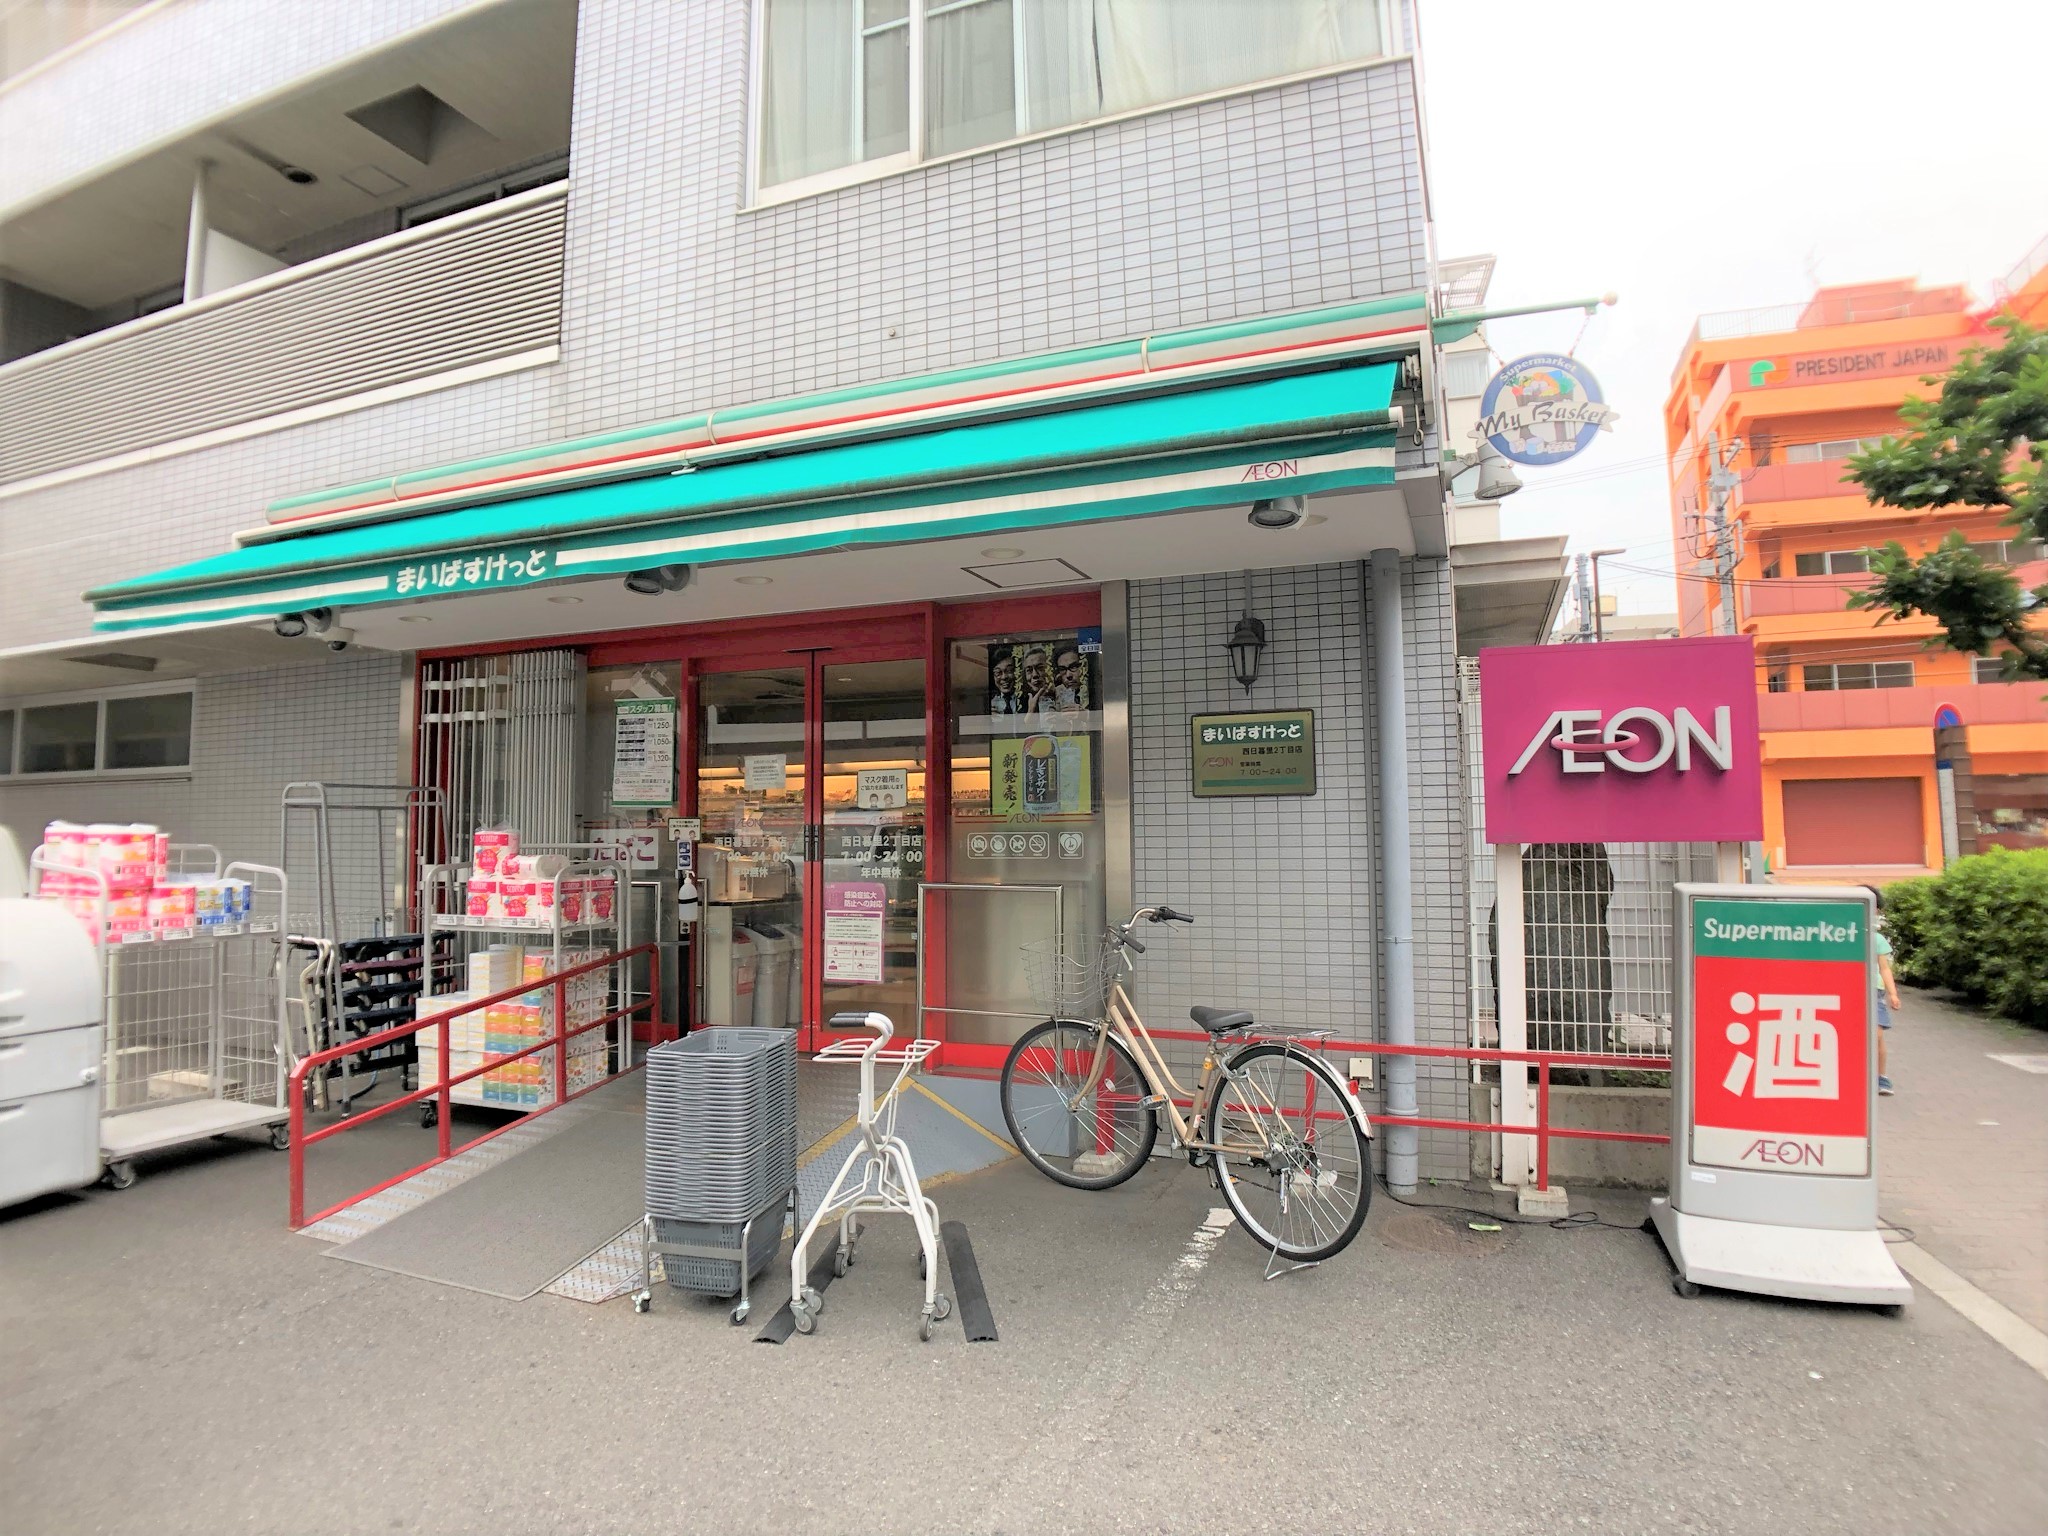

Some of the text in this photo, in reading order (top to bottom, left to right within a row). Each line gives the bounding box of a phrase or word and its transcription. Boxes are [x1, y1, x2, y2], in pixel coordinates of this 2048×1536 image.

[1500, 357, 1578, 382] Supermarket
[1796, 345, 1949, 377] PRESIDENT JAPAN
[1475, 401, 1609, 438] My Basket
[396, 550, 547, 593] まいばすけっと
[1202, 724, 1302, 742] まいばすけっと
[1242, 746, 1303, 756] 西日暮里2丁目店
[864, 775, 900, 784] マスク着用の
[1035, 758, 1047, 802] レモンサワー
[593, 836, 655, 861] たばこ
[841, 835, 923, 847] 西日暮里2丁目店
[861, 867, 902, 878] 年中無休
[1703, 918, 1859, 943] Supermarket
[1722, 992, 1841, 1100] 酒
